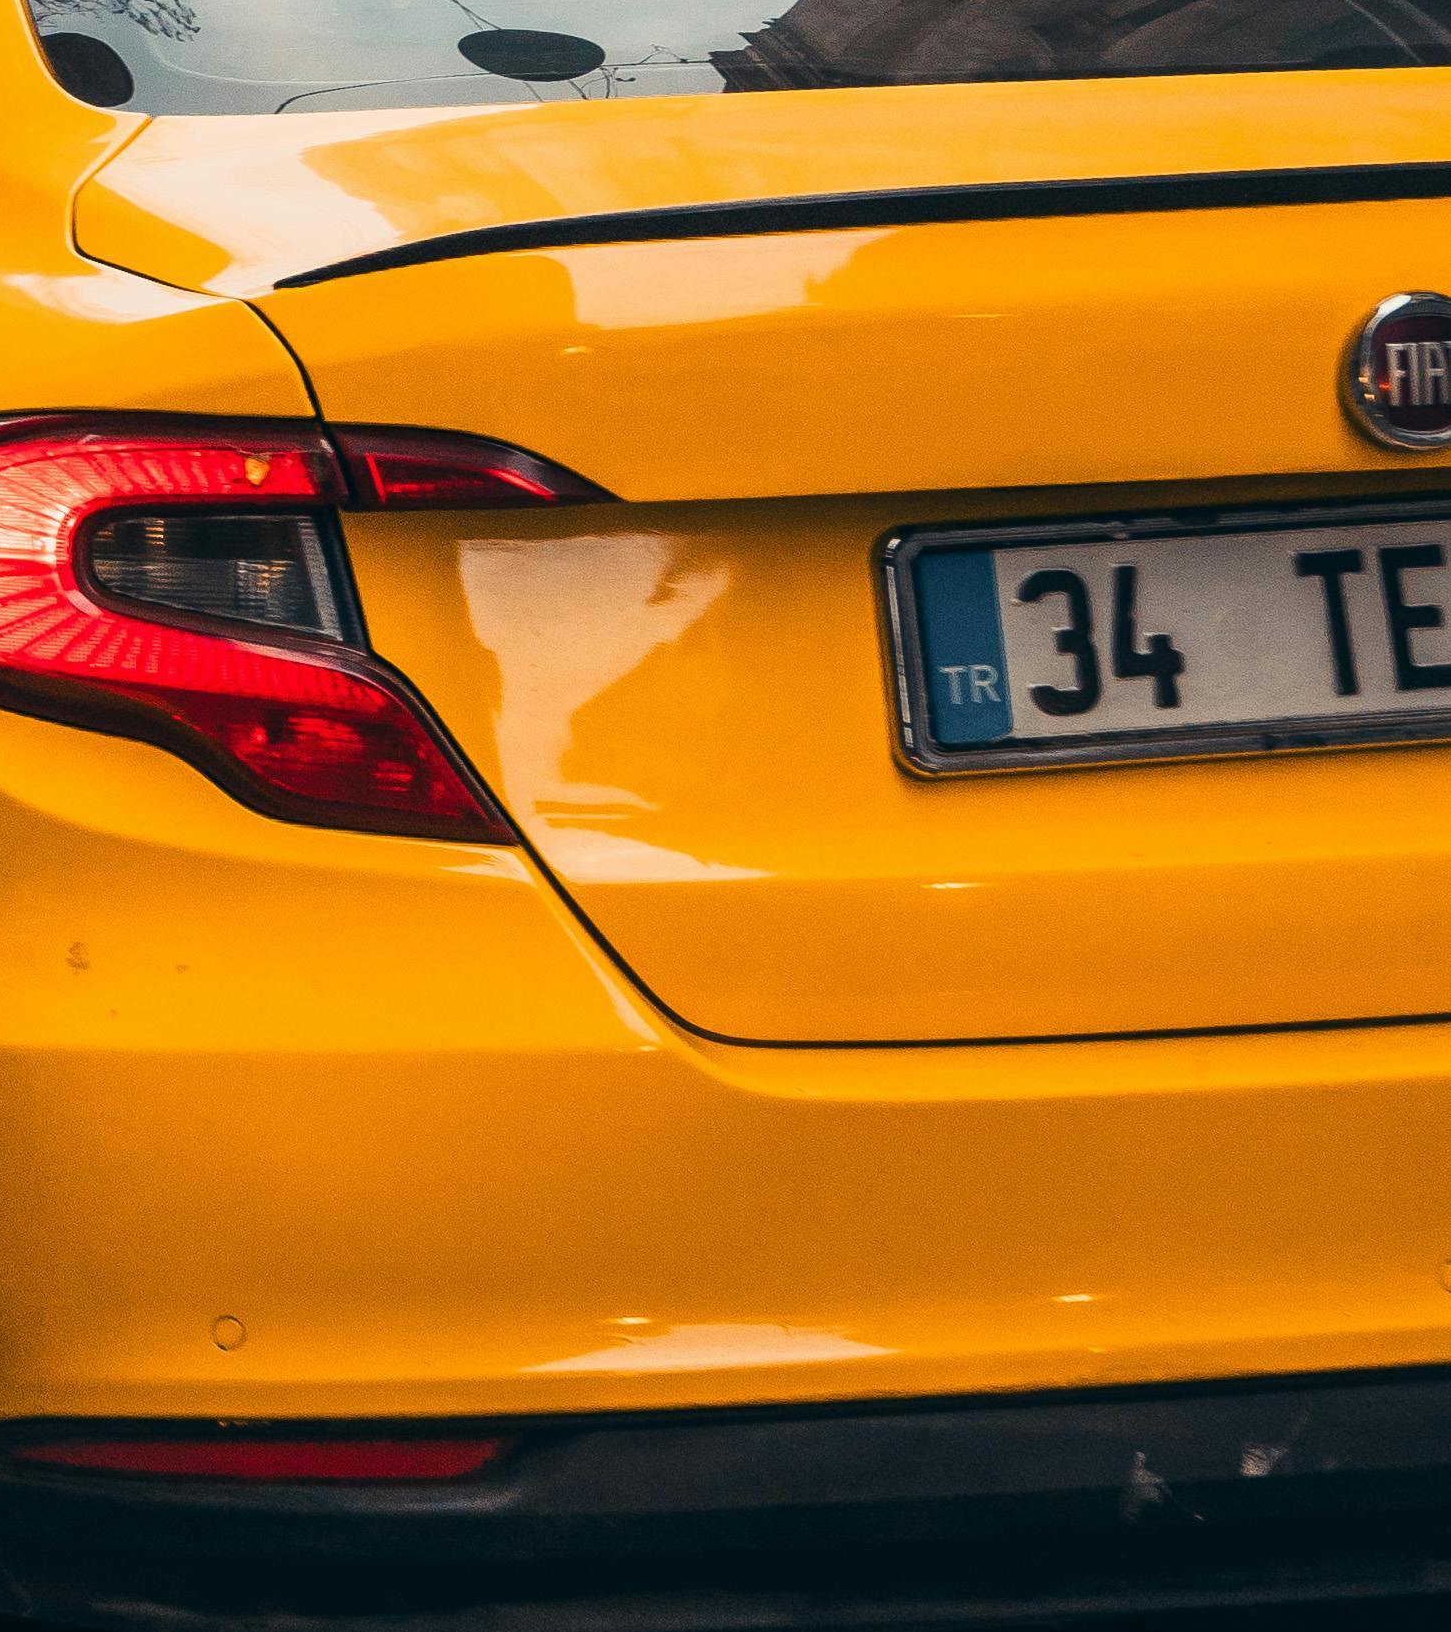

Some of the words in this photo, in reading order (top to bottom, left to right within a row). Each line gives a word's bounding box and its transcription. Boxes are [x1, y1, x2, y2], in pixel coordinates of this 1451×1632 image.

[1017, 563, 1187, 716] 34
[1292, 542, 1451, 697] TE
[940, 664, 1002, 706] TR
